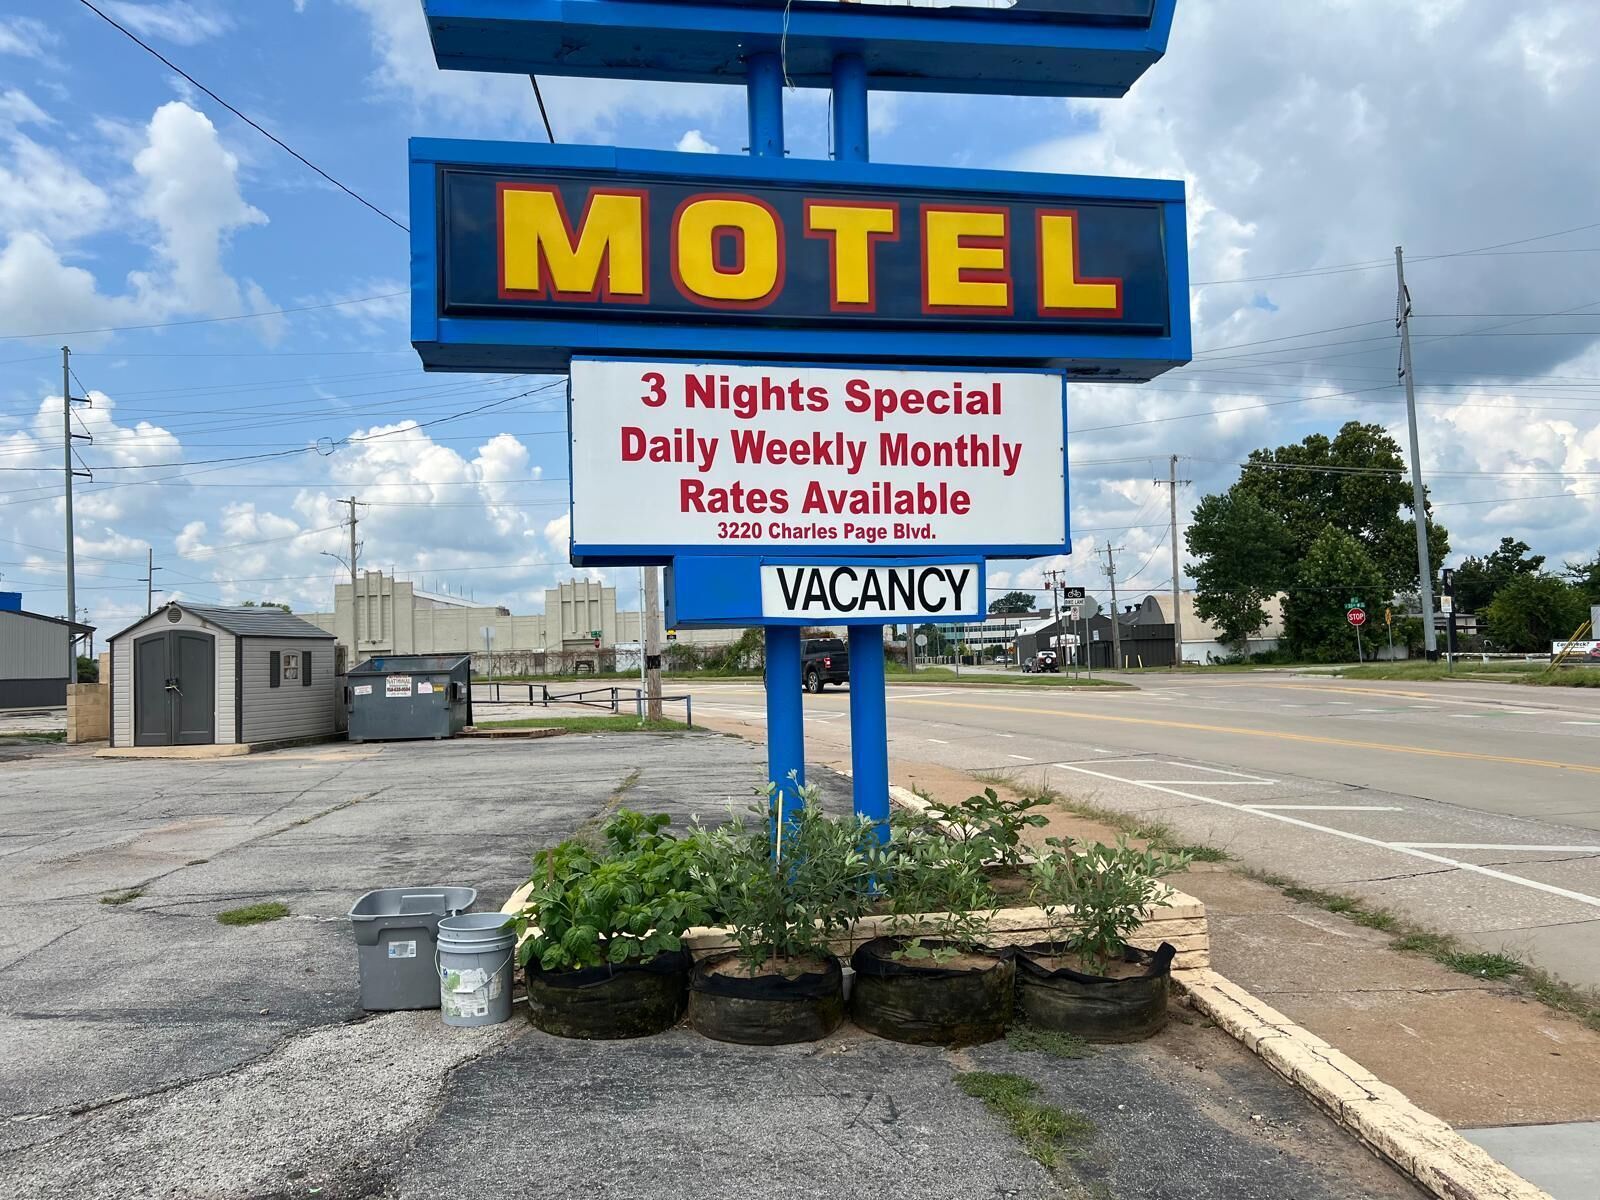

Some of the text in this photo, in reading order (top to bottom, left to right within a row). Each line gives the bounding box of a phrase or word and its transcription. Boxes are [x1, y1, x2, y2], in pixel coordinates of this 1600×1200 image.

[497, 182, 1123, 318] MOTEL
[642, 372, 1002, 422] 3 Nights Special
[621, 426, 1022, 477] Daily Weekly Monthly
[680, 478, 971, 516] Rates Available
[717, 522, 937, 543] 3220 Charles Page Blvd.
[776, 567, 970, 613] VACANCY
[1349, 613, 1364, 621] STOP
